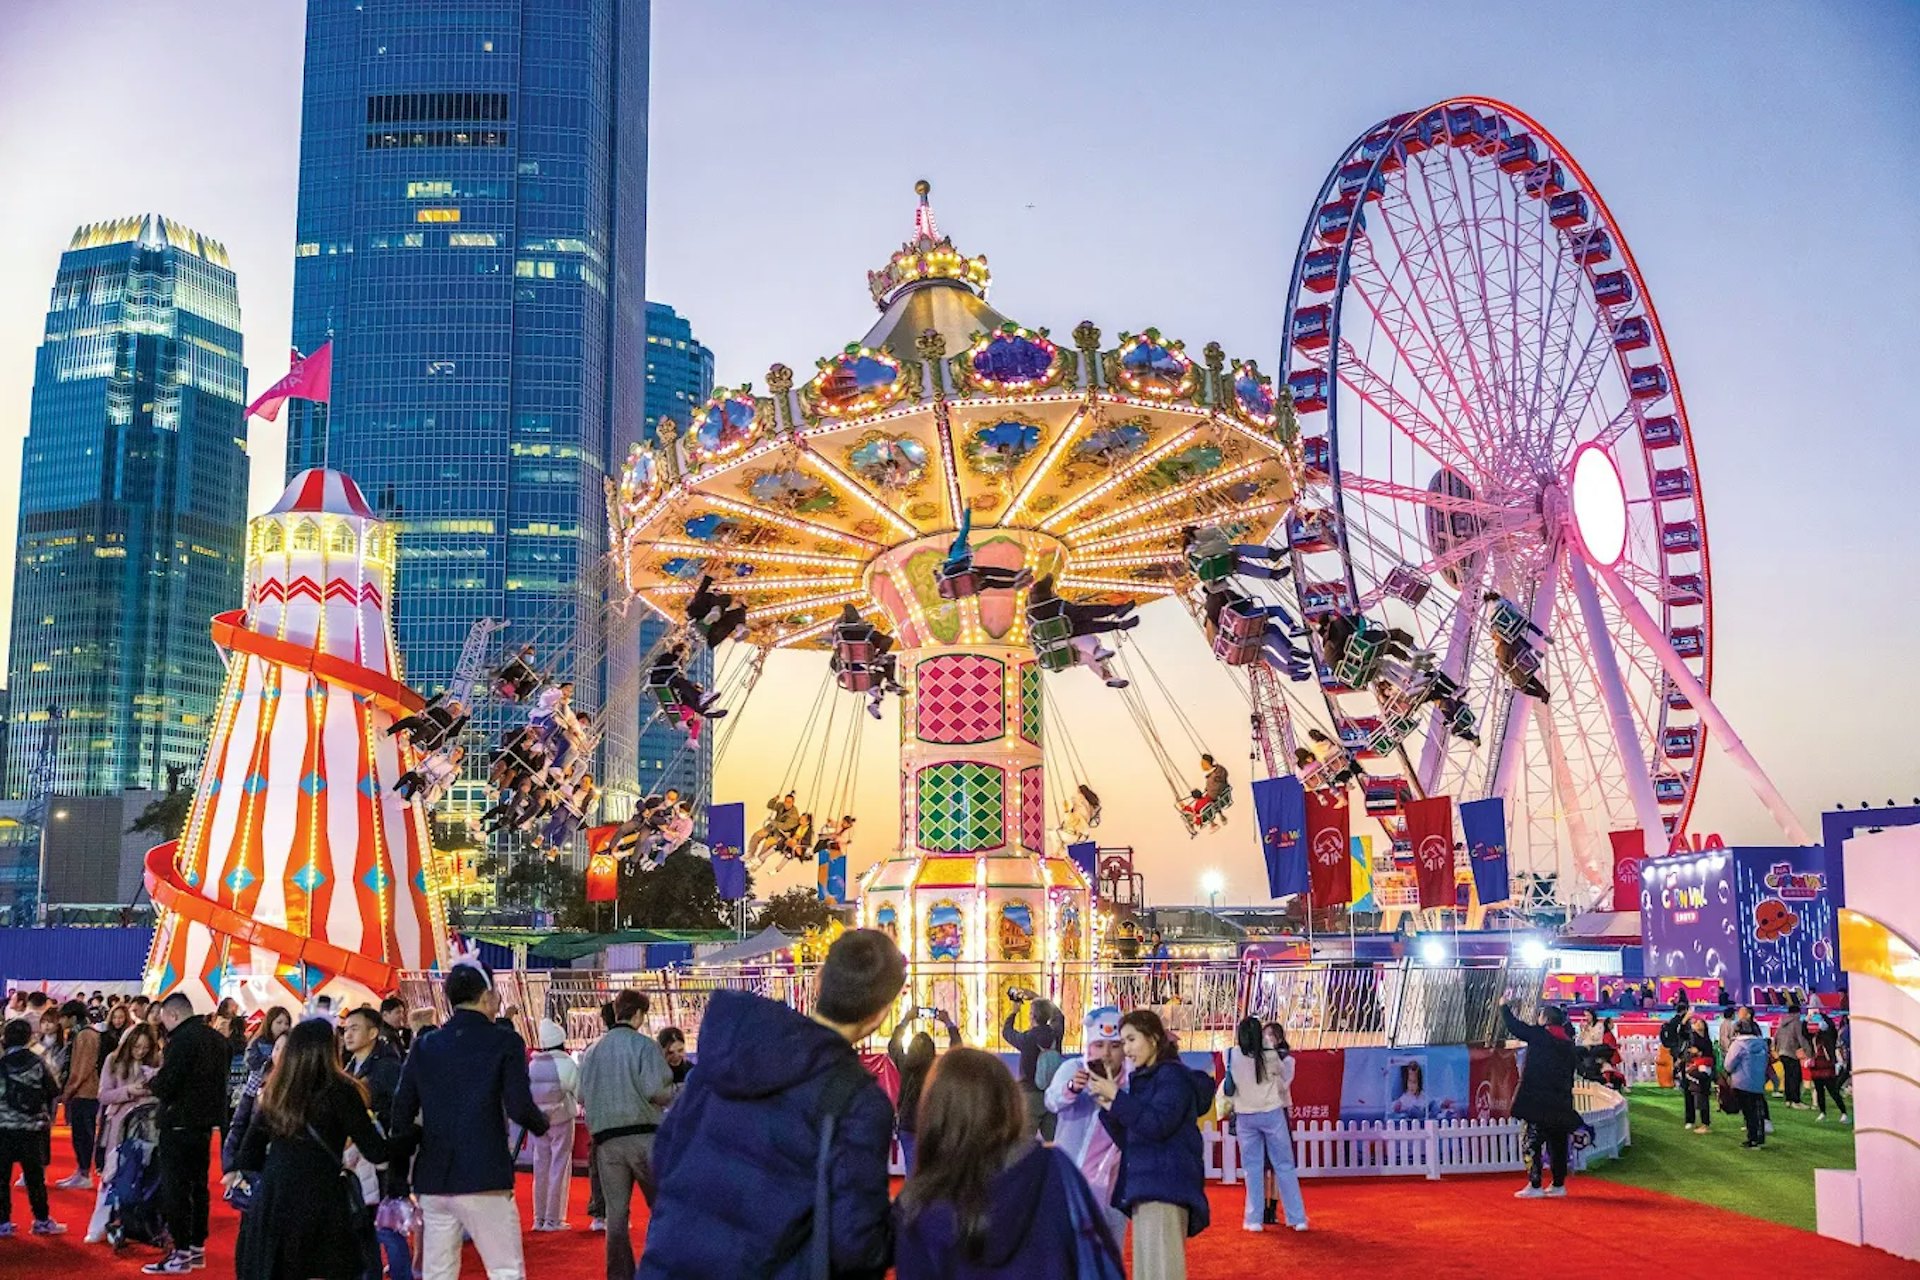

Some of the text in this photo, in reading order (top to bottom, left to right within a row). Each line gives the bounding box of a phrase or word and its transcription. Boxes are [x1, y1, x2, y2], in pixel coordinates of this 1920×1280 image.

[1668, 832, 1726, 857] AIA
[1318, 850, 1343, 866] AIA
[1423, 856, 1446, 872] AIA
